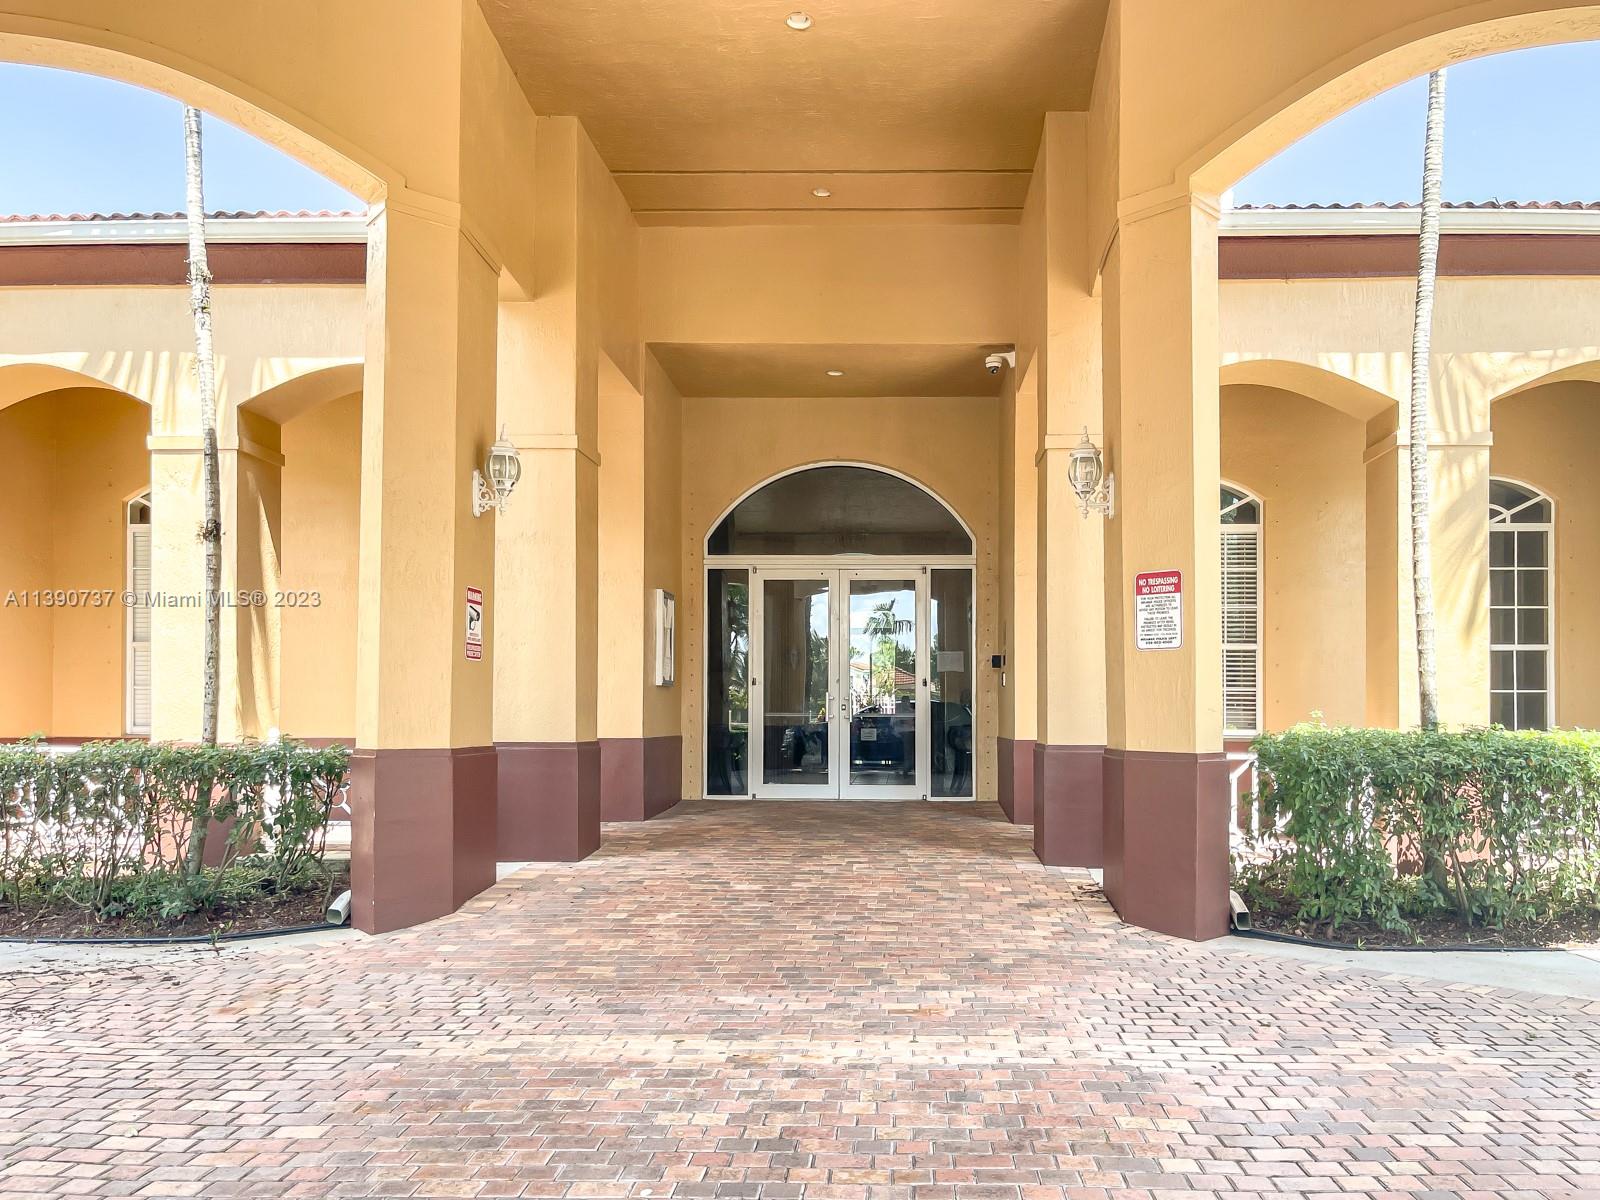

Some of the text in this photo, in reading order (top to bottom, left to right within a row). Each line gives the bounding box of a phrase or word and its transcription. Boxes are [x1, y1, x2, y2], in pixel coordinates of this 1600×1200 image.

[1147, 576, 1178, 585] TRESPASSING
[1142, 585, 1175, 594] NO LOITERING
